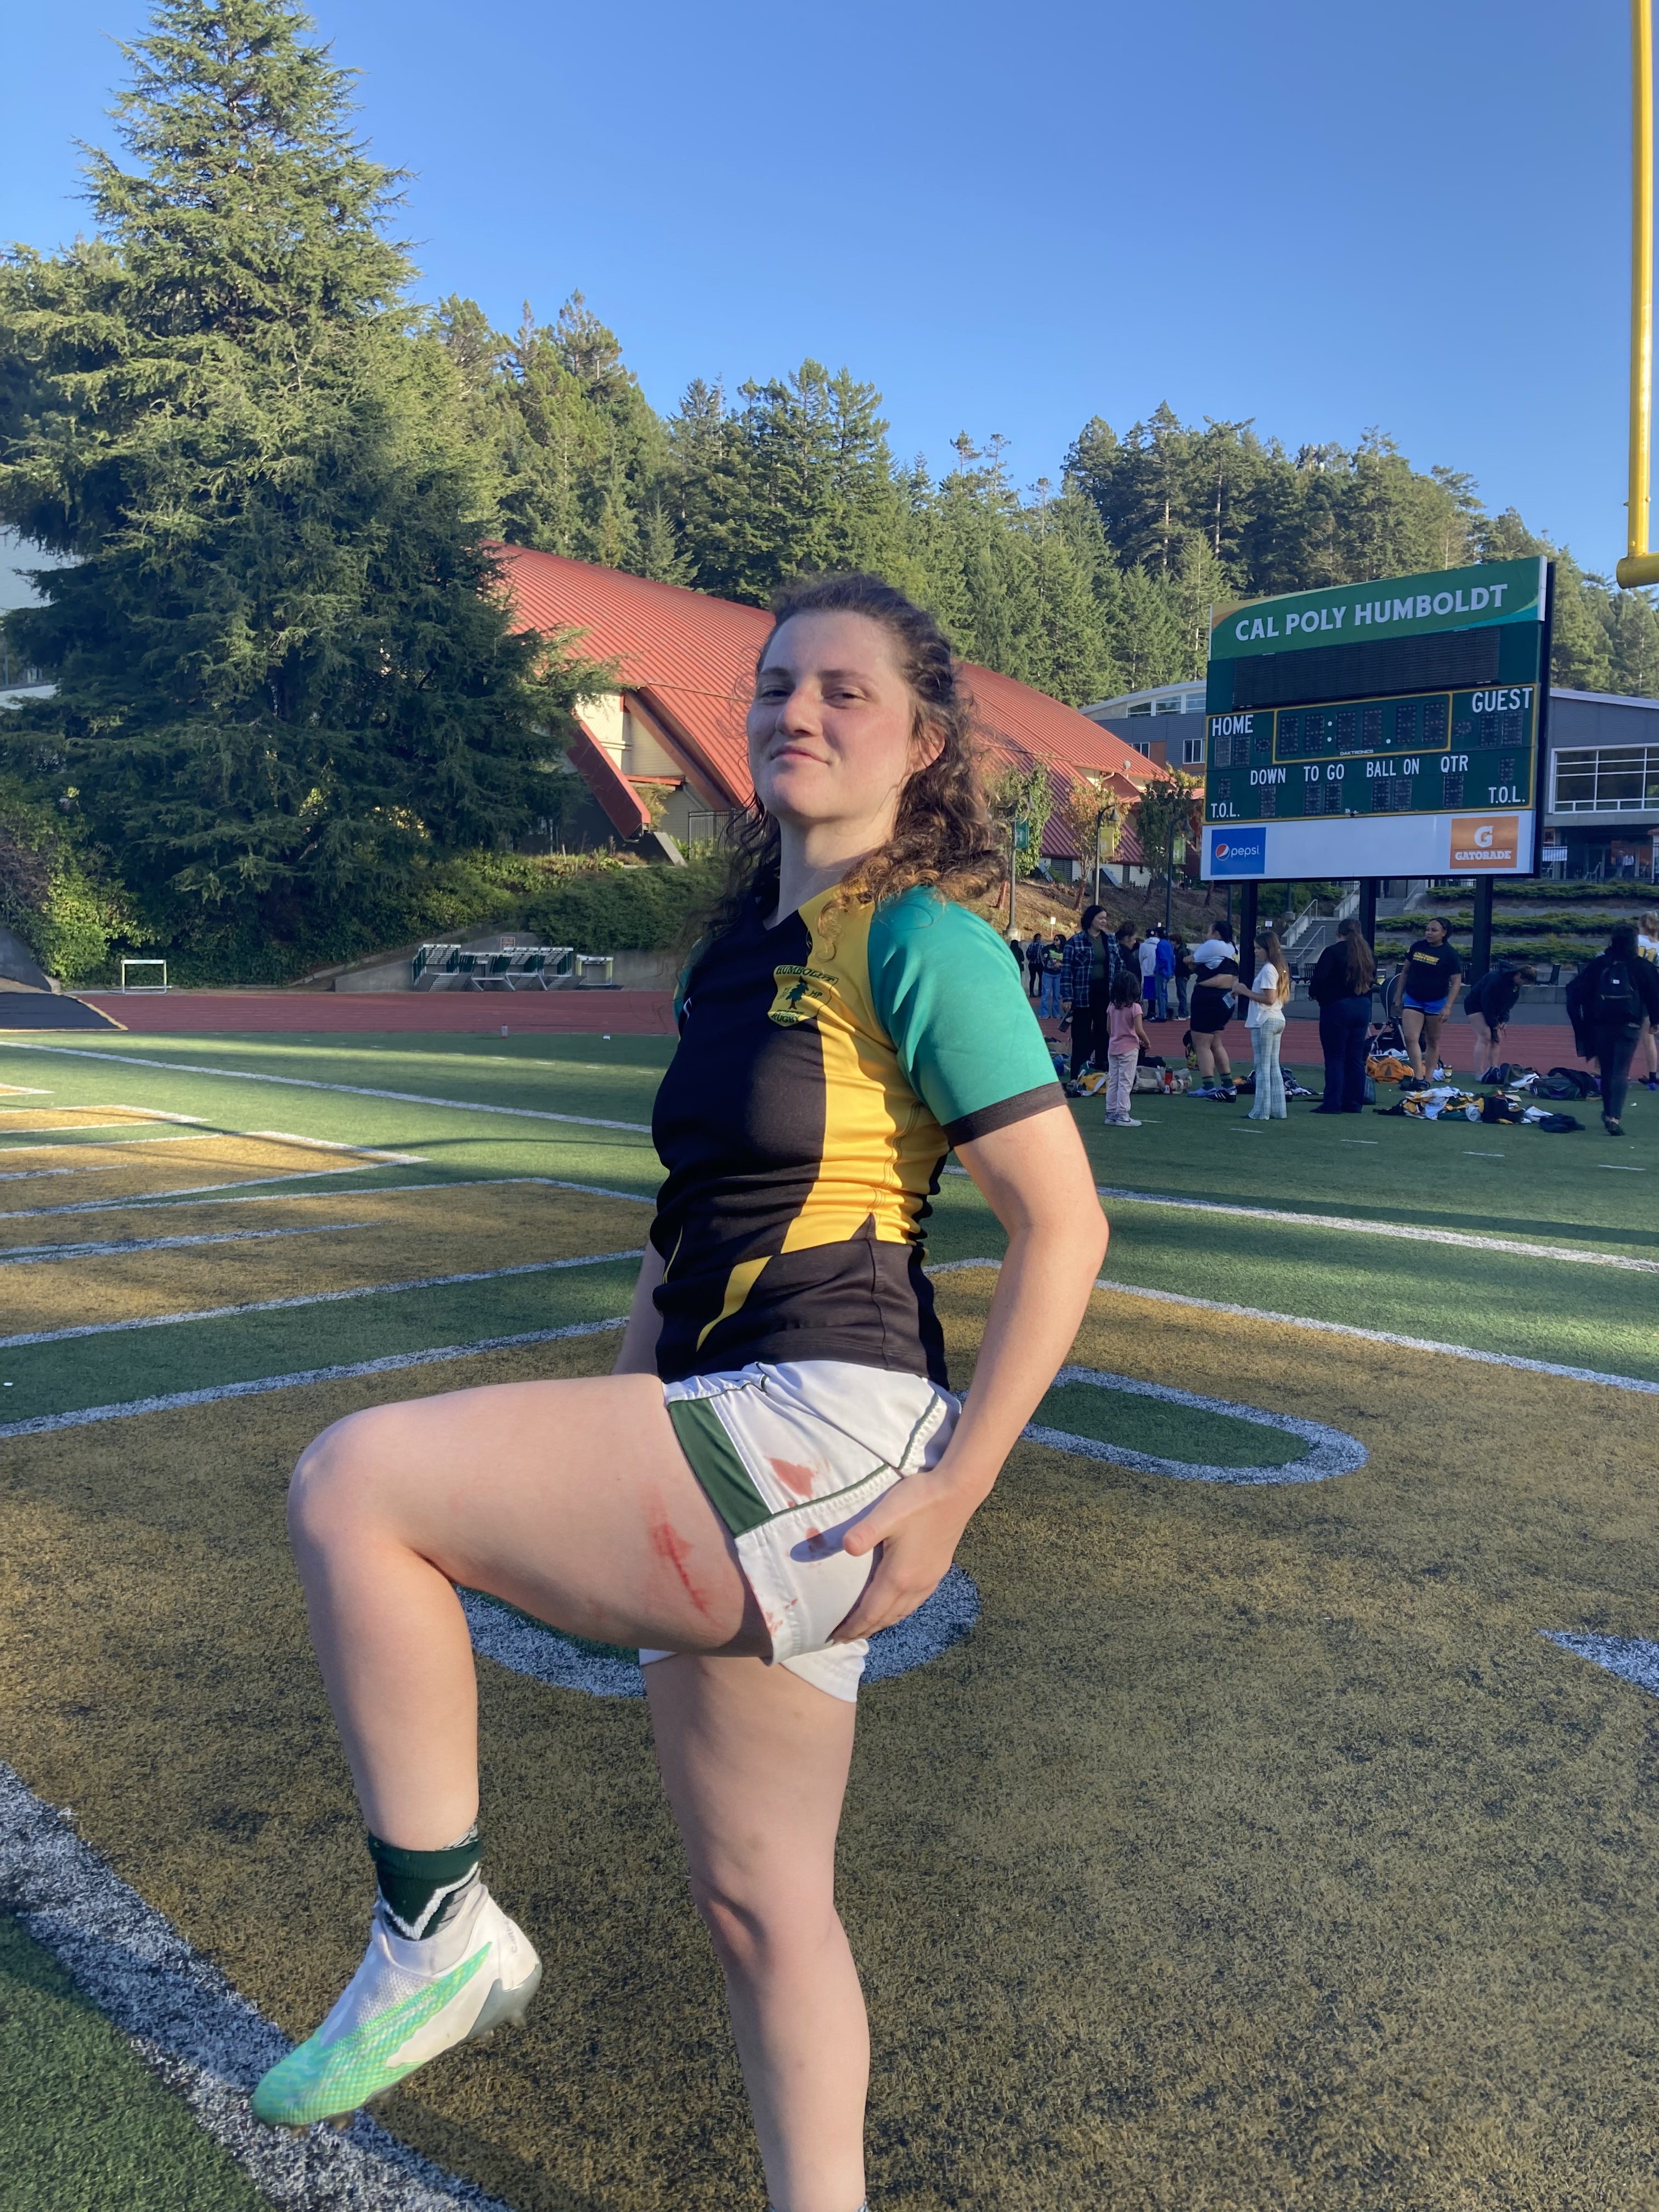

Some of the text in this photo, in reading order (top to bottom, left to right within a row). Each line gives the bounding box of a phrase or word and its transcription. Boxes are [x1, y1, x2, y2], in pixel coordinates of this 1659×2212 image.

[1235, 584, 1508, 641] CAL POLY HUMBOLDT
[1472, 687, 1533, 713] GUEST
[1212, 714, 1254, 736] HOME
[1304, 764, 1344, 781] TO GO
[1366, 758, 1419, 778] BALL ON
[1441, 755, 1469, 773] QTR
[1250, 768, 1286, 785] DOWN
[1488, 786, 1525, 803] T.O.L.
[1211, 802, 1240, 818] T.O.L.
[1475, 826, 1494, 848] G
[1231, 845, 1260, 858] pepsi
[1455, 850, 1512, 860] GATORADE
[776, 966, 834, 982] HUMBOLDT
[771, 1013, 799, 1023] RUGBY
